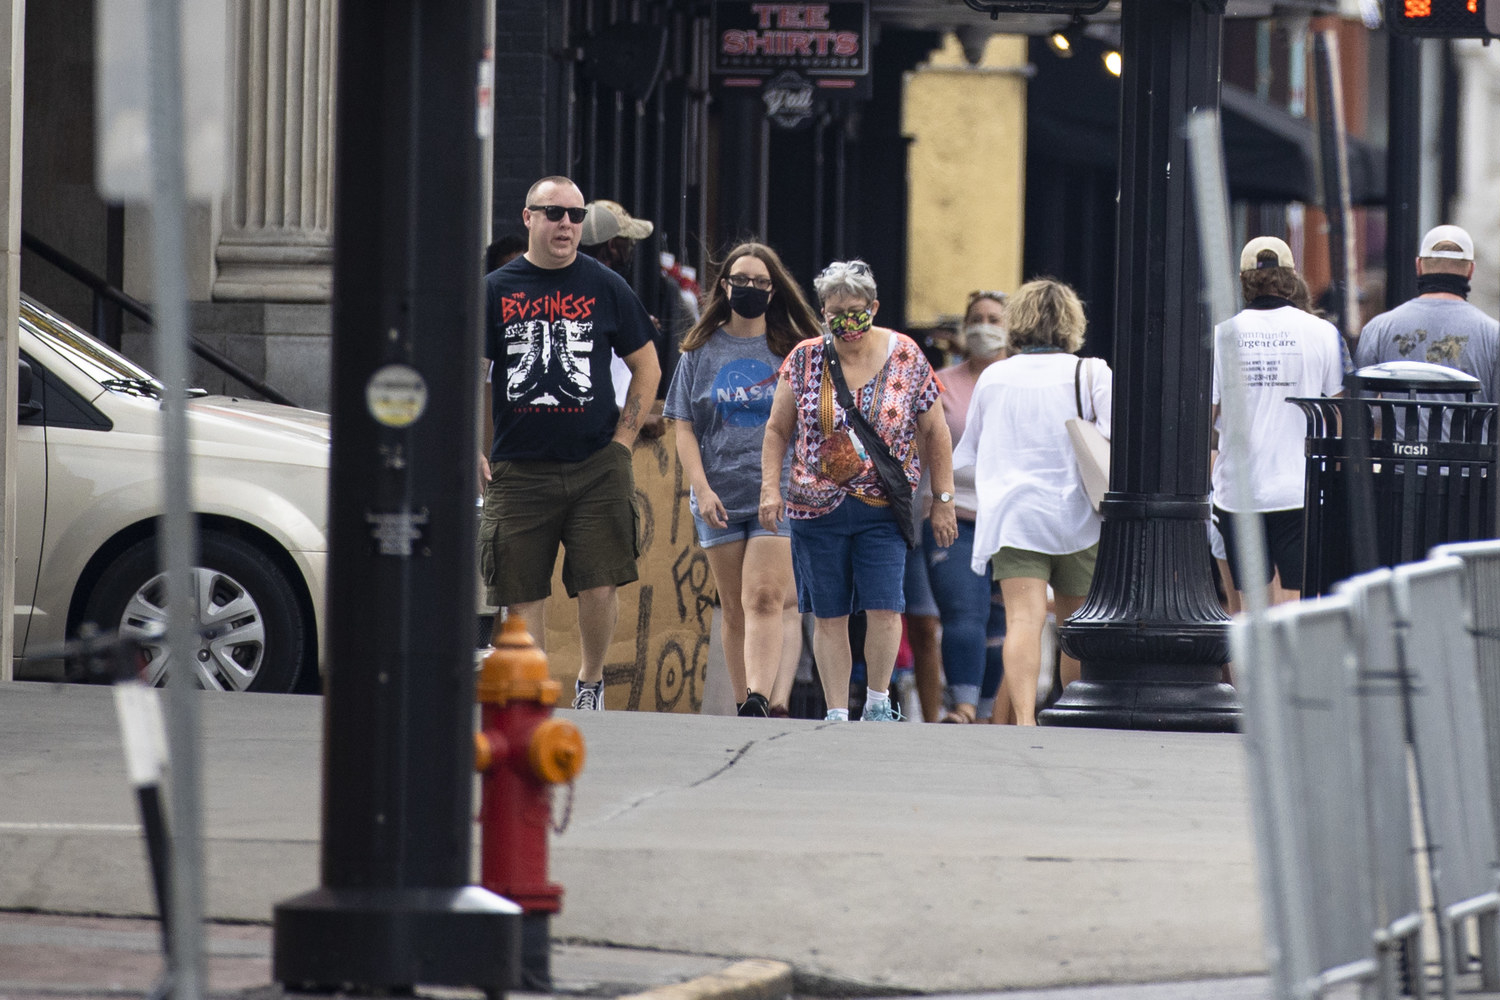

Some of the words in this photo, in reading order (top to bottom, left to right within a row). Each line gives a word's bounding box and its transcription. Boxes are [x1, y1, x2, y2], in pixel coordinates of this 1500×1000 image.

[752, 3, 830, 28] TEE
[722, 29, 859, 56] SHIRTS
[1239, 331, 1290, 340] ommunity
[1238, 340, 1270, 349] Urgent
[1272, 340, 1296, 348] Care
[717, 384, 776, 403] NASA
[1392, 442, 1429, 456] Trash
